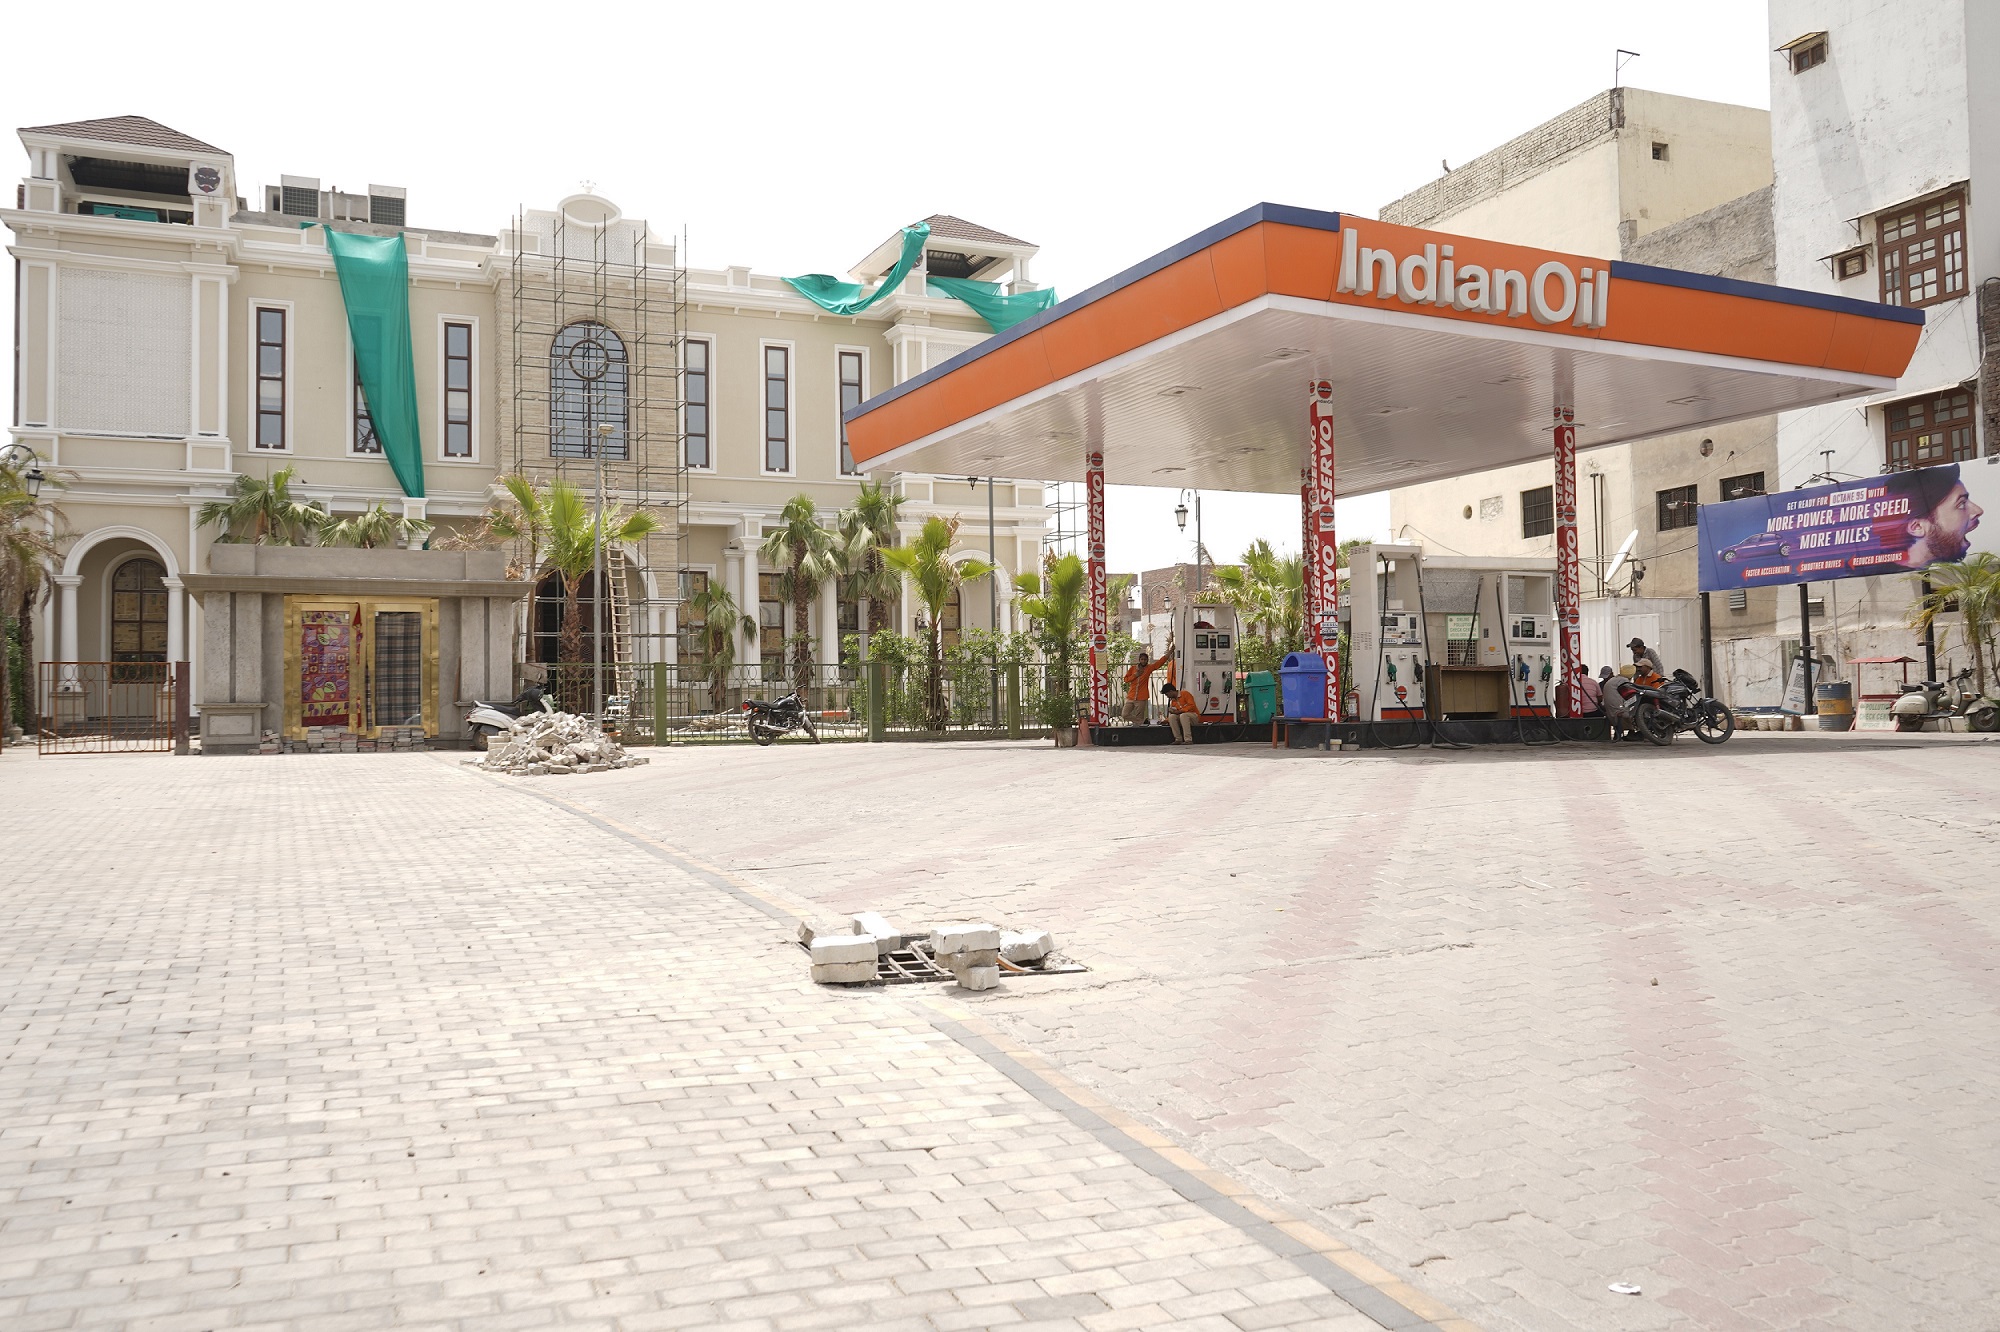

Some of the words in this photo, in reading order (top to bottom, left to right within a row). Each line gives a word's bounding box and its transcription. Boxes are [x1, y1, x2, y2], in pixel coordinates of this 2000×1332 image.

[1337, 228, 1609, 329] IndianOil
[1320, 419, 1333, 505] SERVO
[1555, 446, 1564, 506] SERVO
[1564, 429, 1575, 506] SERVO
[1092, 474, 1104, 543] SERVO
[1766, 515, 1795, 533] MORE
[1796, 509, 1836, 528] POWER,
[1839, 504, 1870, 523] MORE
[1873, 498, 1911, 518] SPEED,
[1787, 501, 1797, 511] GET
[1798, 498, 1816, 509] READY
[1816, 496, 1828, 507] FOR
[1832, 491, 1854, 504] OCTANE
[1855, 490, 1864, 501] 95
[1868, 488, 1884, 498] WITH
[1567, 529, 1579, 606] SERVO
[1800, 532, 1831, 549] MORE
[1800, 560, 1824, 572] SMOOTHER
[1825, 559, 1842, 569] DRIVES
[1853, 555, 1875, 566] REDUCED
[1875, 552, 1903, 564] EMISSIONS
[1094, 565, 1106, 635] SERVO
[1558, 547, 1568, 607] SERVO
[1745, 568, 1760, 577] FASTER
[1760, 565, 1790, 576] ACCELERATION
[1327, 655, 1338, 723] SERVO
[1560, 648, 1568, 683] RVO
